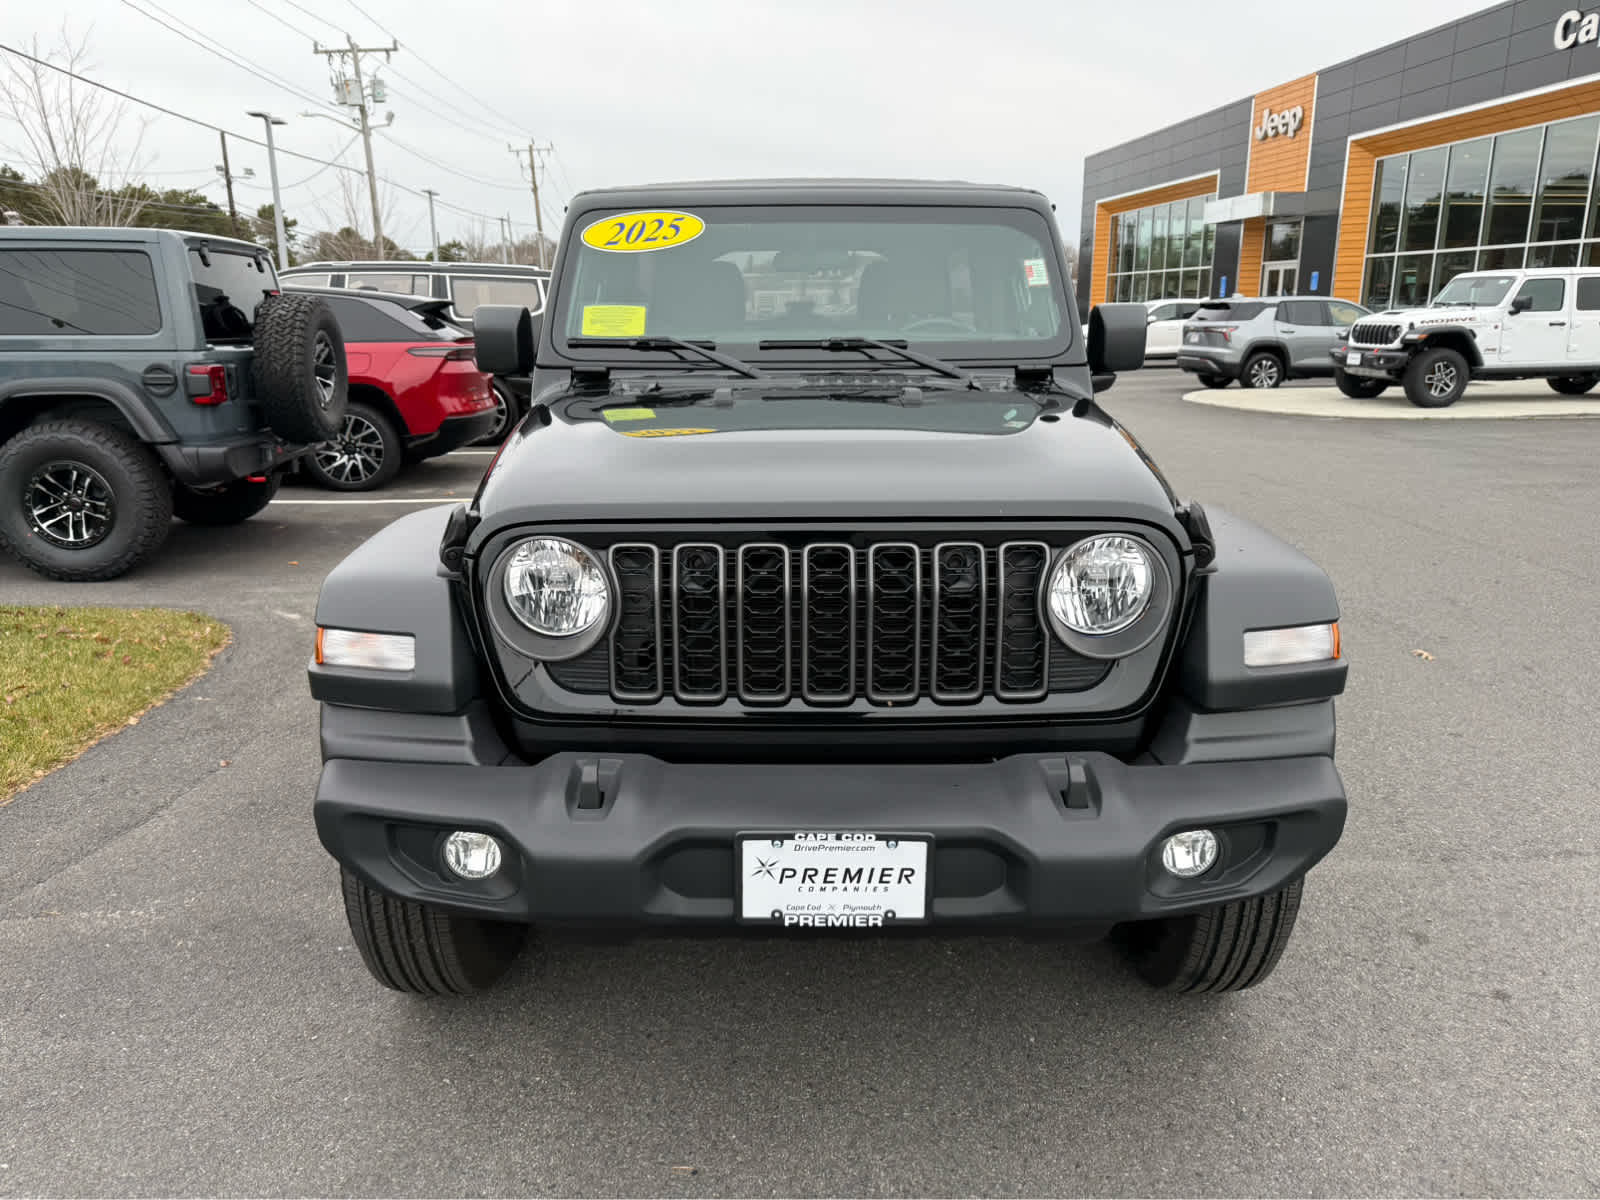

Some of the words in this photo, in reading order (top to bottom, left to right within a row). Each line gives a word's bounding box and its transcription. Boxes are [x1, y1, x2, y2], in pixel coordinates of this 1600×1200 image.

[1554, 10, 1600, 49] Ca
[1255, 105, 1303, 140] Jeep
[603, 217, 685, 246] 2025
[794, 833, 837, 841] CAPE
[841, 833, 877, 841] COD
[794, 844, 876, 852] DrivePremier.com
[779, 867, 916, 884] PREMIER
[786, 904, 806, 912] Cape
[806, 903, 822, 911] Cod
[842, 903, 882, 912] Plymouth
[784, 914, 883, 927] PREMIER
